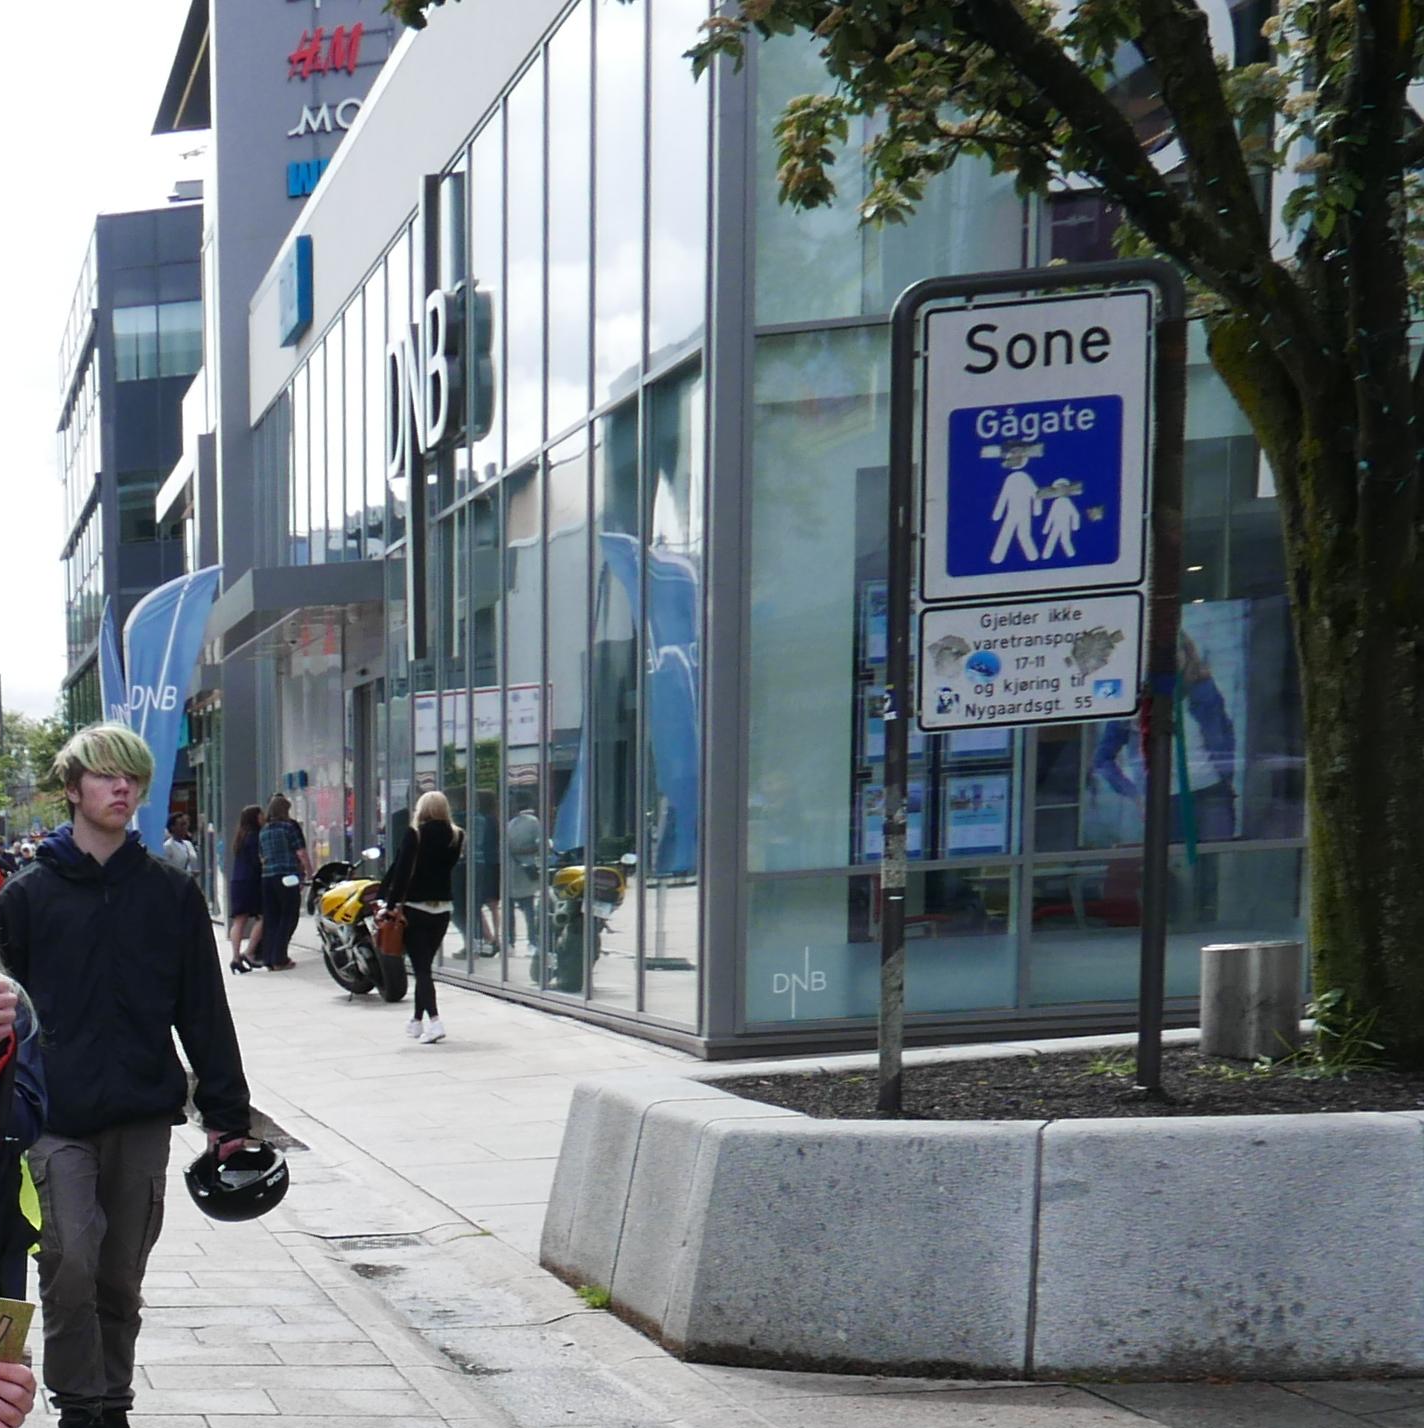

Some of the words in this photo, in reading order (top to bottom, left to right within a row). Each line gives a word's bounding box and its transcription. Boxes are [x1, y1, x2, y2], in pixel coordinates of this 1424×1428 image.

[288, 98, 363, 136] MO
[964, 323, 1111, 374] Sone
[386, 288, 450, 480] DNB
[976, 403, 1096, 442] Gågate
[980, 611, 1041, 631] Gjelder
[1048, 607, 1083, 623] ikke
[973, 631, 1087, 651] varetranspor
[1015, 655, 1046, 670] 17-11
[131, 685, 177, 711] DNB
[974, 683, 995, 698] og
[1004, 676, 1061, 696] kjøring
[1071, 673, 1088, 688] til
[1074, 696, 1093, 709] 55
